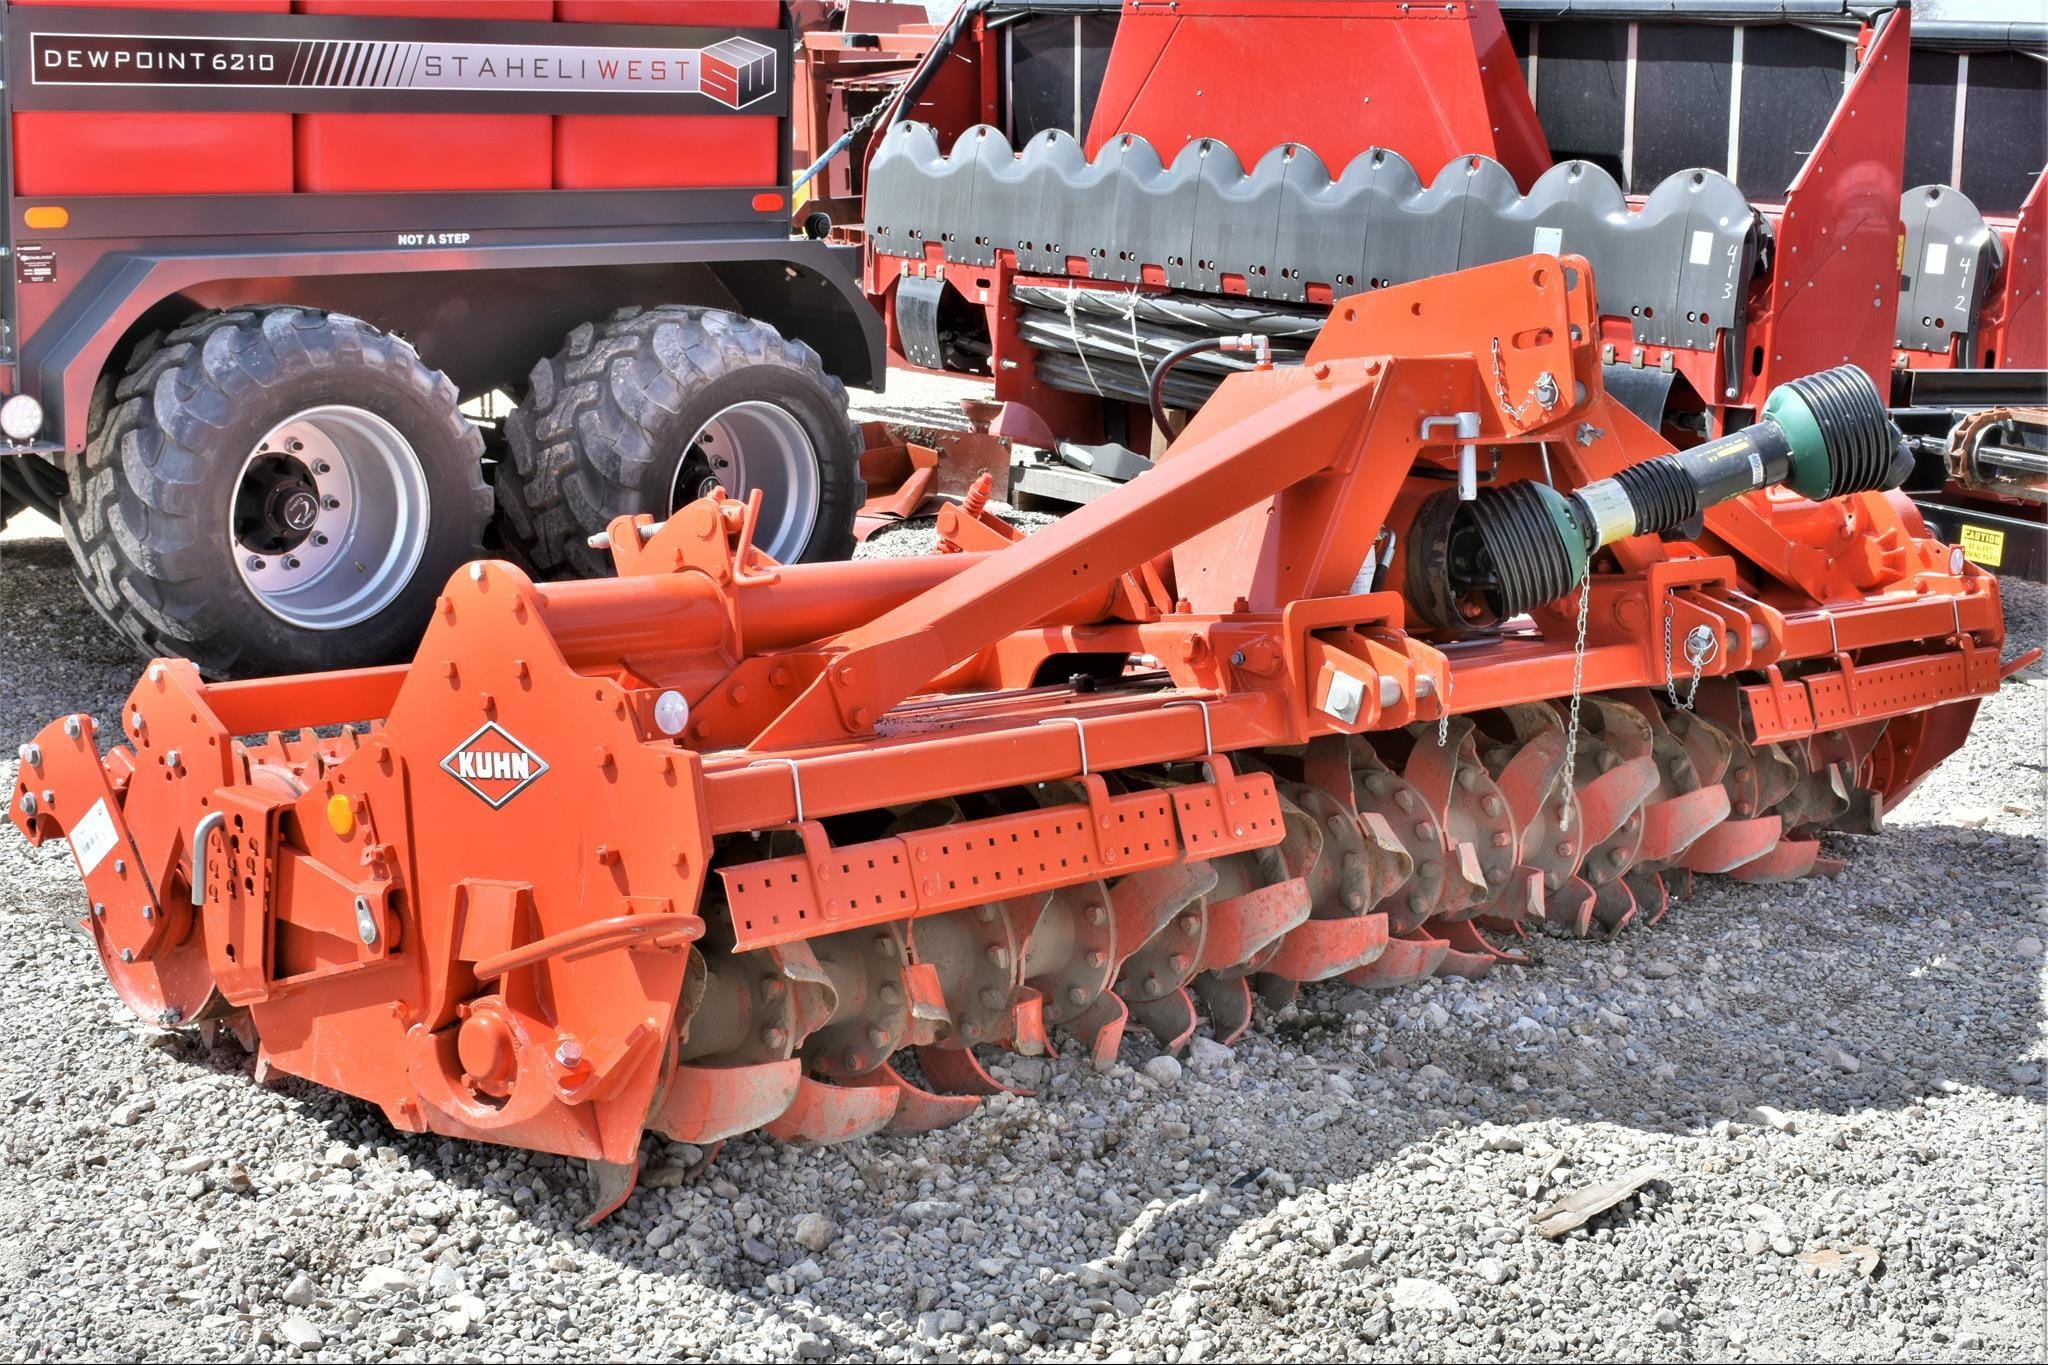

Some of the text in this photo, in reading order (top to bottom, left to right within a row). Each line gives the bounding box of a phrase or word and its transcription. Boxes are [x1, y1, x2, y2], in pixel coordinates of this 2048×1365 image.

[44, 49, 275, 71] DEWPOINT 6210
[398, 233, 470, 246] NOT A STEP
[1964, 529, 2001, 545] CAUTION
[458, 751, 530, 780] KUHN
